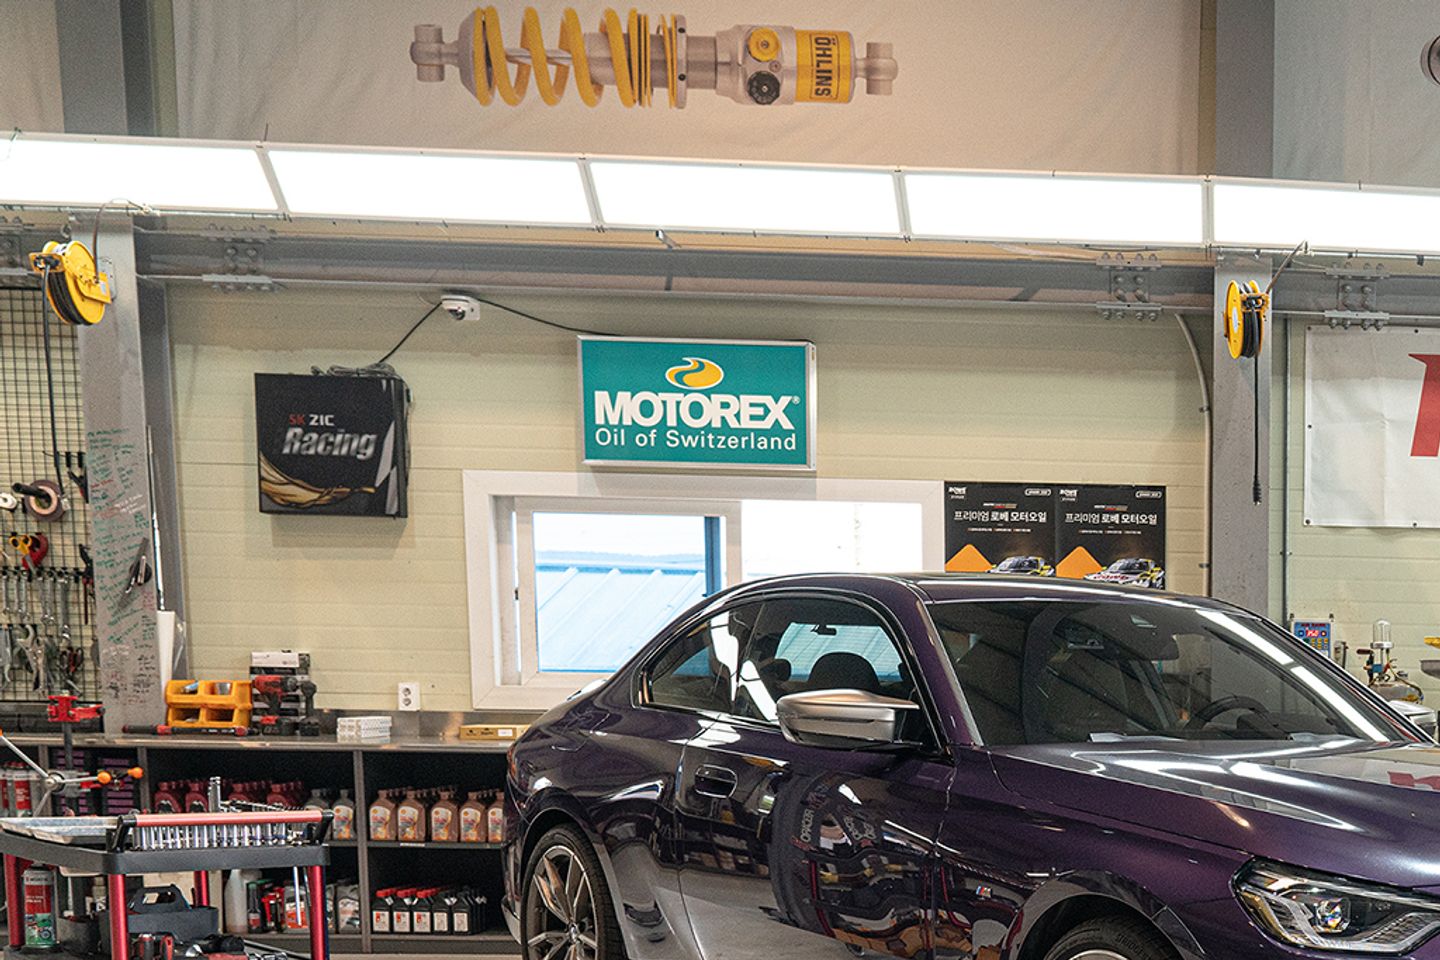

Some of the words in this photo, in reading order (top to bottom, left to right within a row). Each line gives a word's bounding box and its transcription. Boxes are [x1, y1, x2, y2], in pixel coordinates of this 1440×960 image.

[289, 414, 305, 425] SK
[308, 414, 336, 426] ZIC
[594, 390, 795, 430] MOTOREX
[282, 427, 378, 460] Racing
[595, 427, 626, 447] Oil
[635, 429, 657, 448] of
[666, 431, 797, 450] Switzerland
